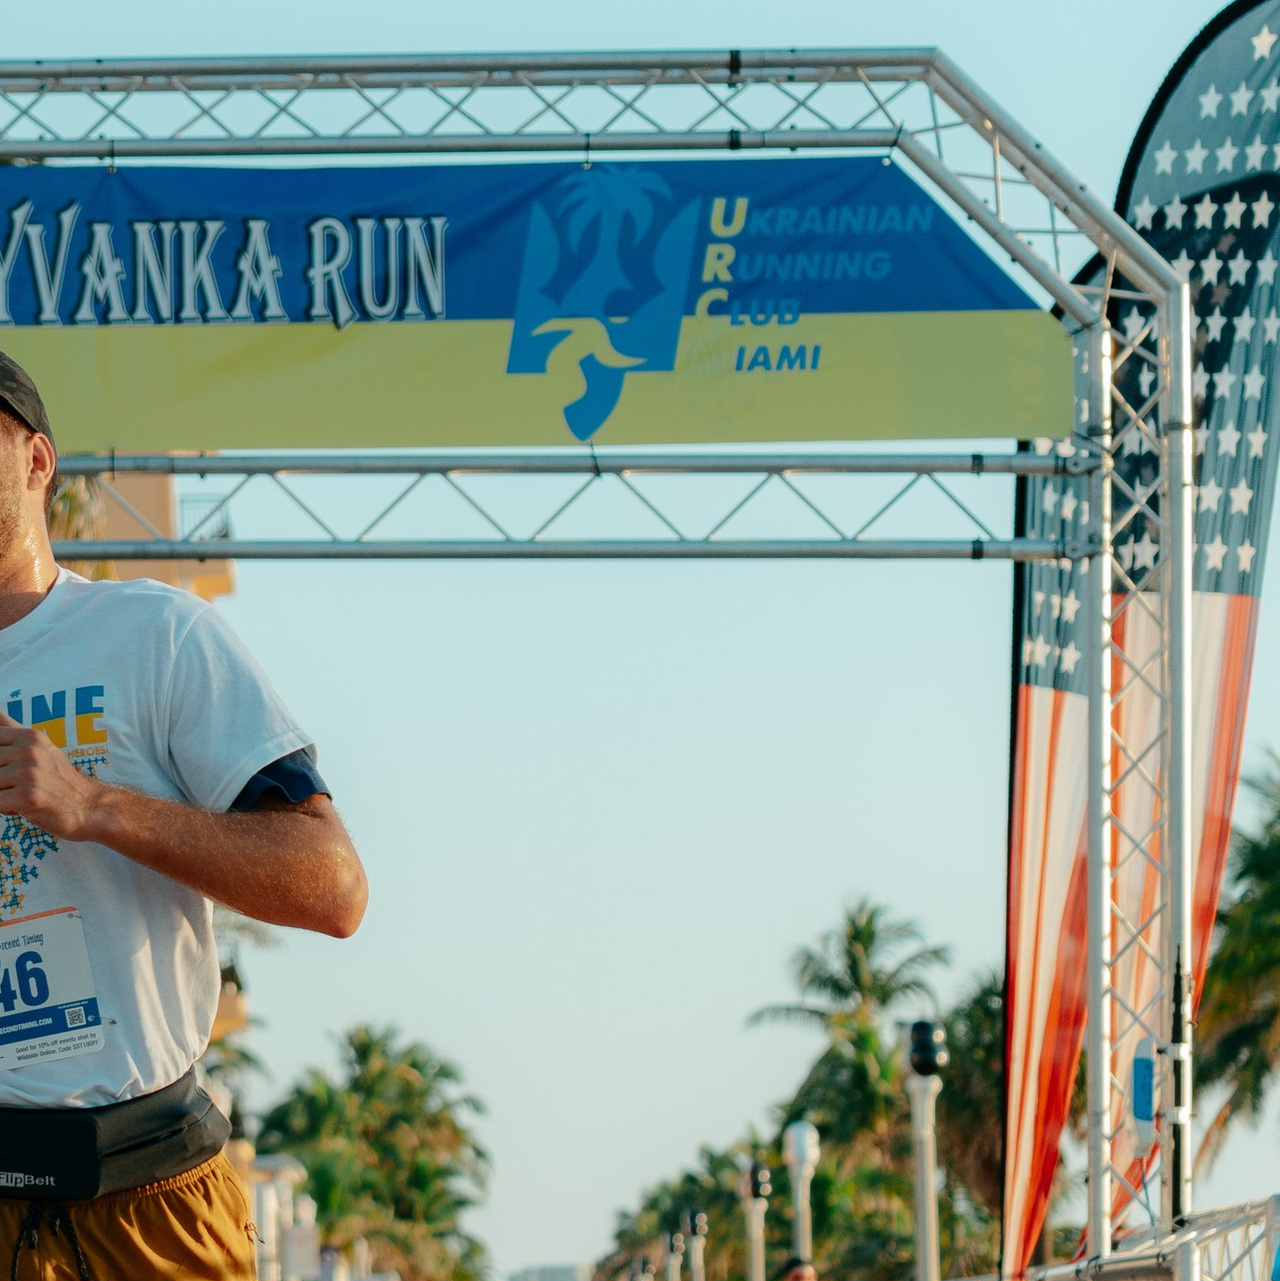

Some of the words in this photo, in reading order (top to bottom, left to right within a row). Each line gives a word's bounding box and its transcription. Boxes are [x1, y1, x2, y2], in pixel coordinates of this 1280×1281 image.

[710, 197, 934, 237] UKRAINIAN
[307, 216, 450, 331] RUN
[702, 243, 892, 282] RUNNING
[696, 288, 801, 326] CLUB
[22, 933, 44, 947] Timing
[15, 1045, 29, 1054] Good
[59, 1036, 77, 1044] events
[90, 1032, 97, 1040] by
[58, 1045, 72, 1053] Code
